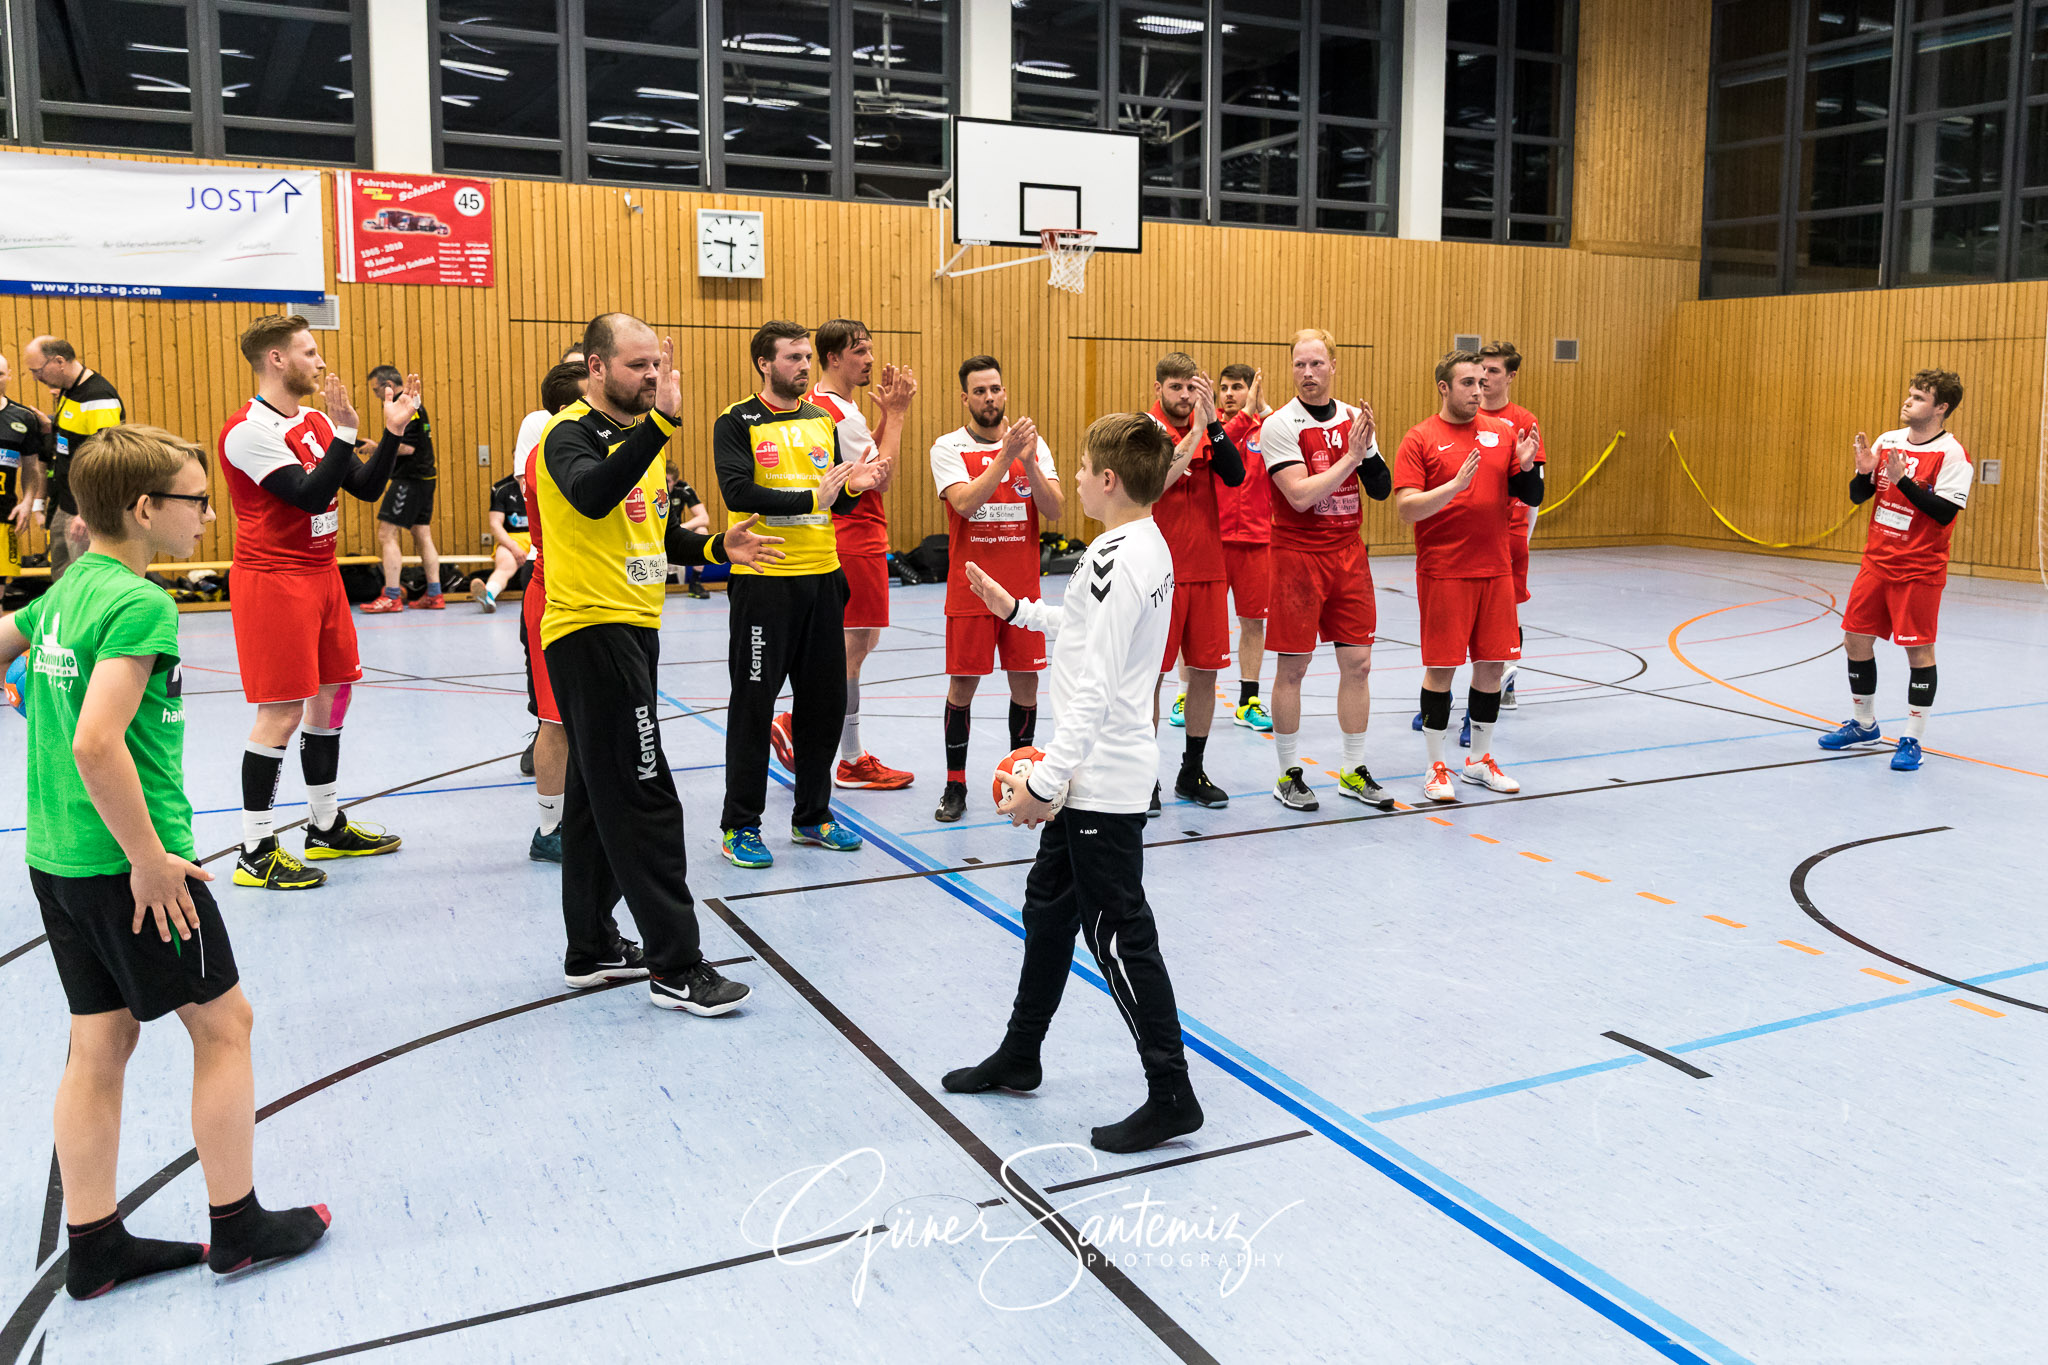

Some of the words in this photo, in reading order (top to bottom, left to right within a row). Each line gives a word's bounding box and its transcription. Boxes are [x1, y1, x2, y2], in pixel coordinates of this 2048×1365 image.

[357, 178, 413, 190] Fahrschule
[398, 180, 446, 202] Schlicht
[186, 187, 264, 213] JOST
[458, 193, 480, 210] 45
[31, 283, 162, 297] www.jost-ag.com
[779, 425, 805, 448] 12
[1322, 429, 1343, 449] 14
[970, 536, 997, 544] Umzüge
[998, 535, 1026, 543] Würzburg
[750, 625, 767, 682] Kempa
[635, 705, 658, 781] Kempa
